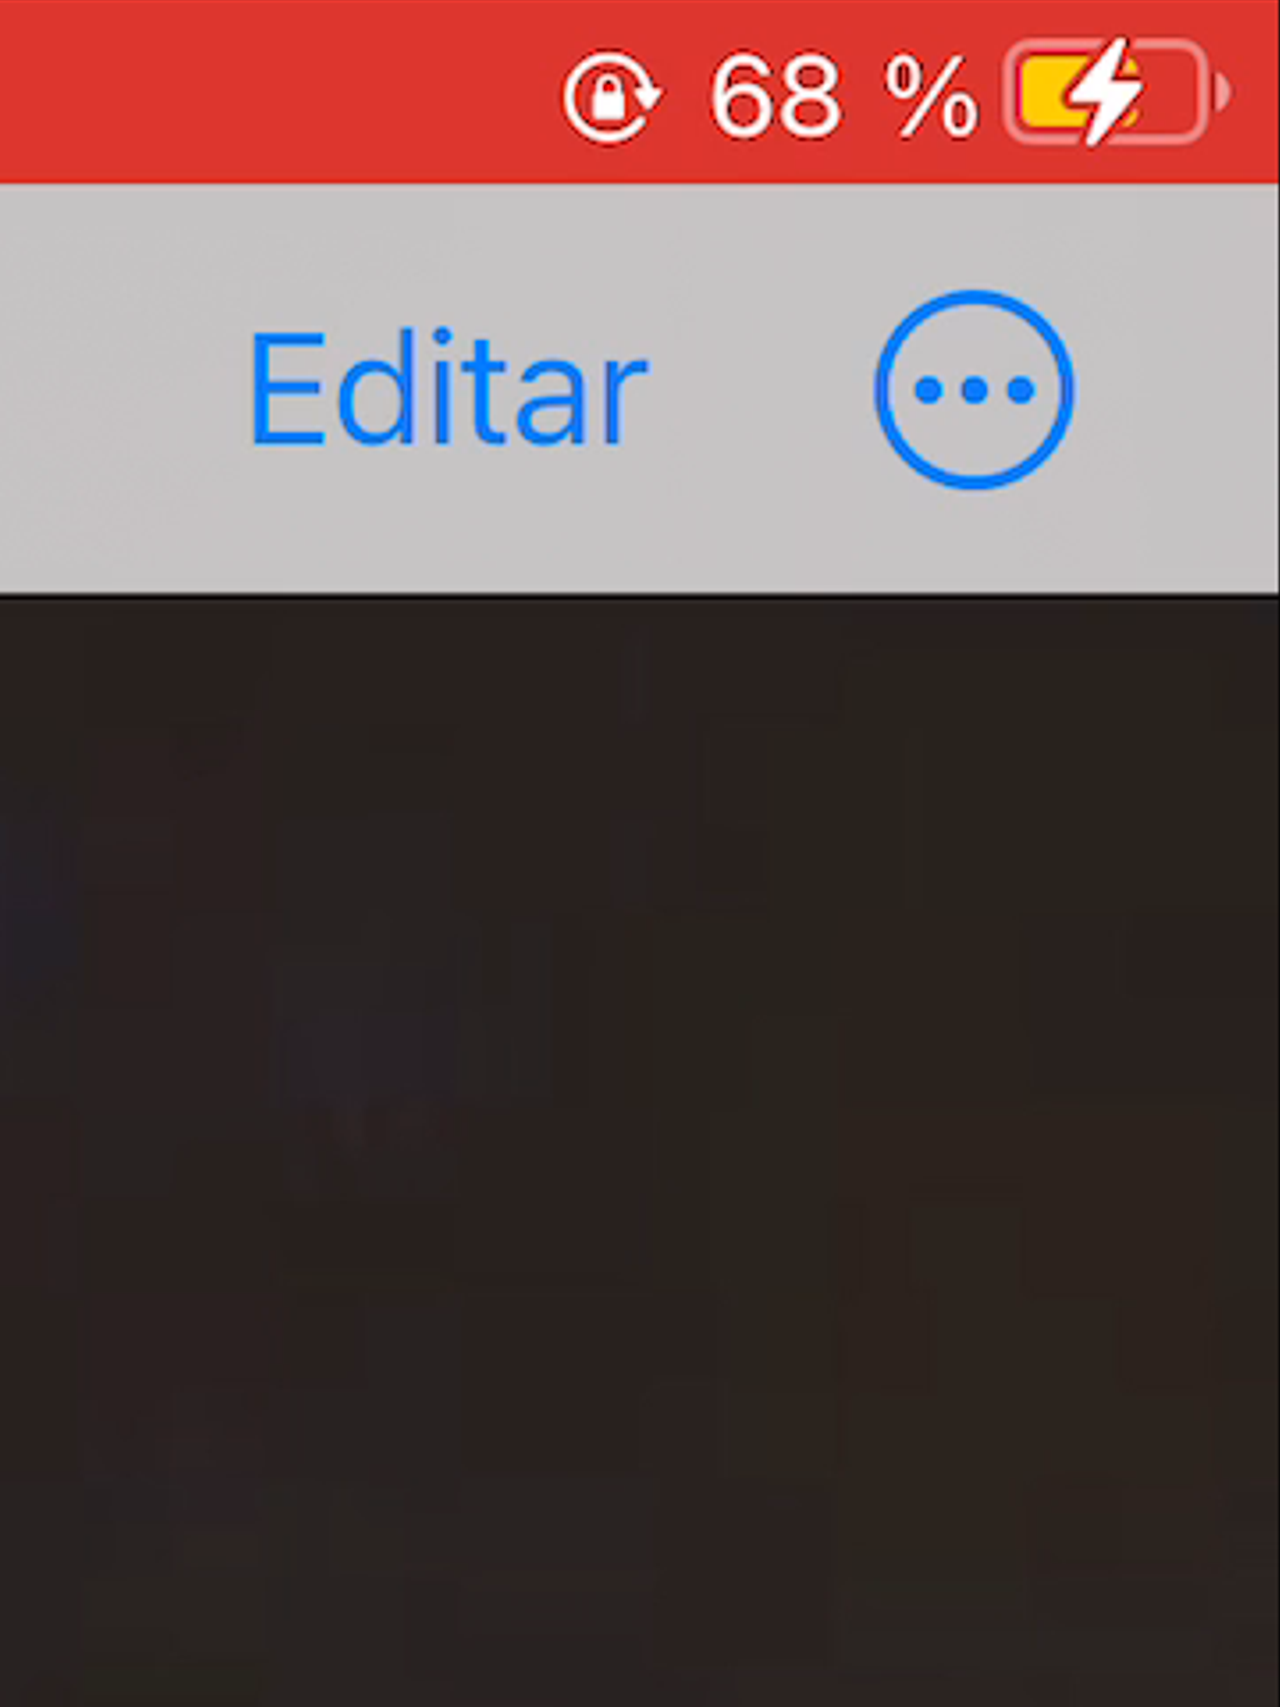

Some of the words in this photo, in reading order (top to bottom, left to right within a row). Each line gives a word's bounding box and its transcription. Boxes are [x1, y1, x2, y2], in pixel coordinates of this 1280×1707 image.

[712, 52, 841, 138] 68
[885, 53, 982, 138] %
[252, 324, 650, 448] Editar
